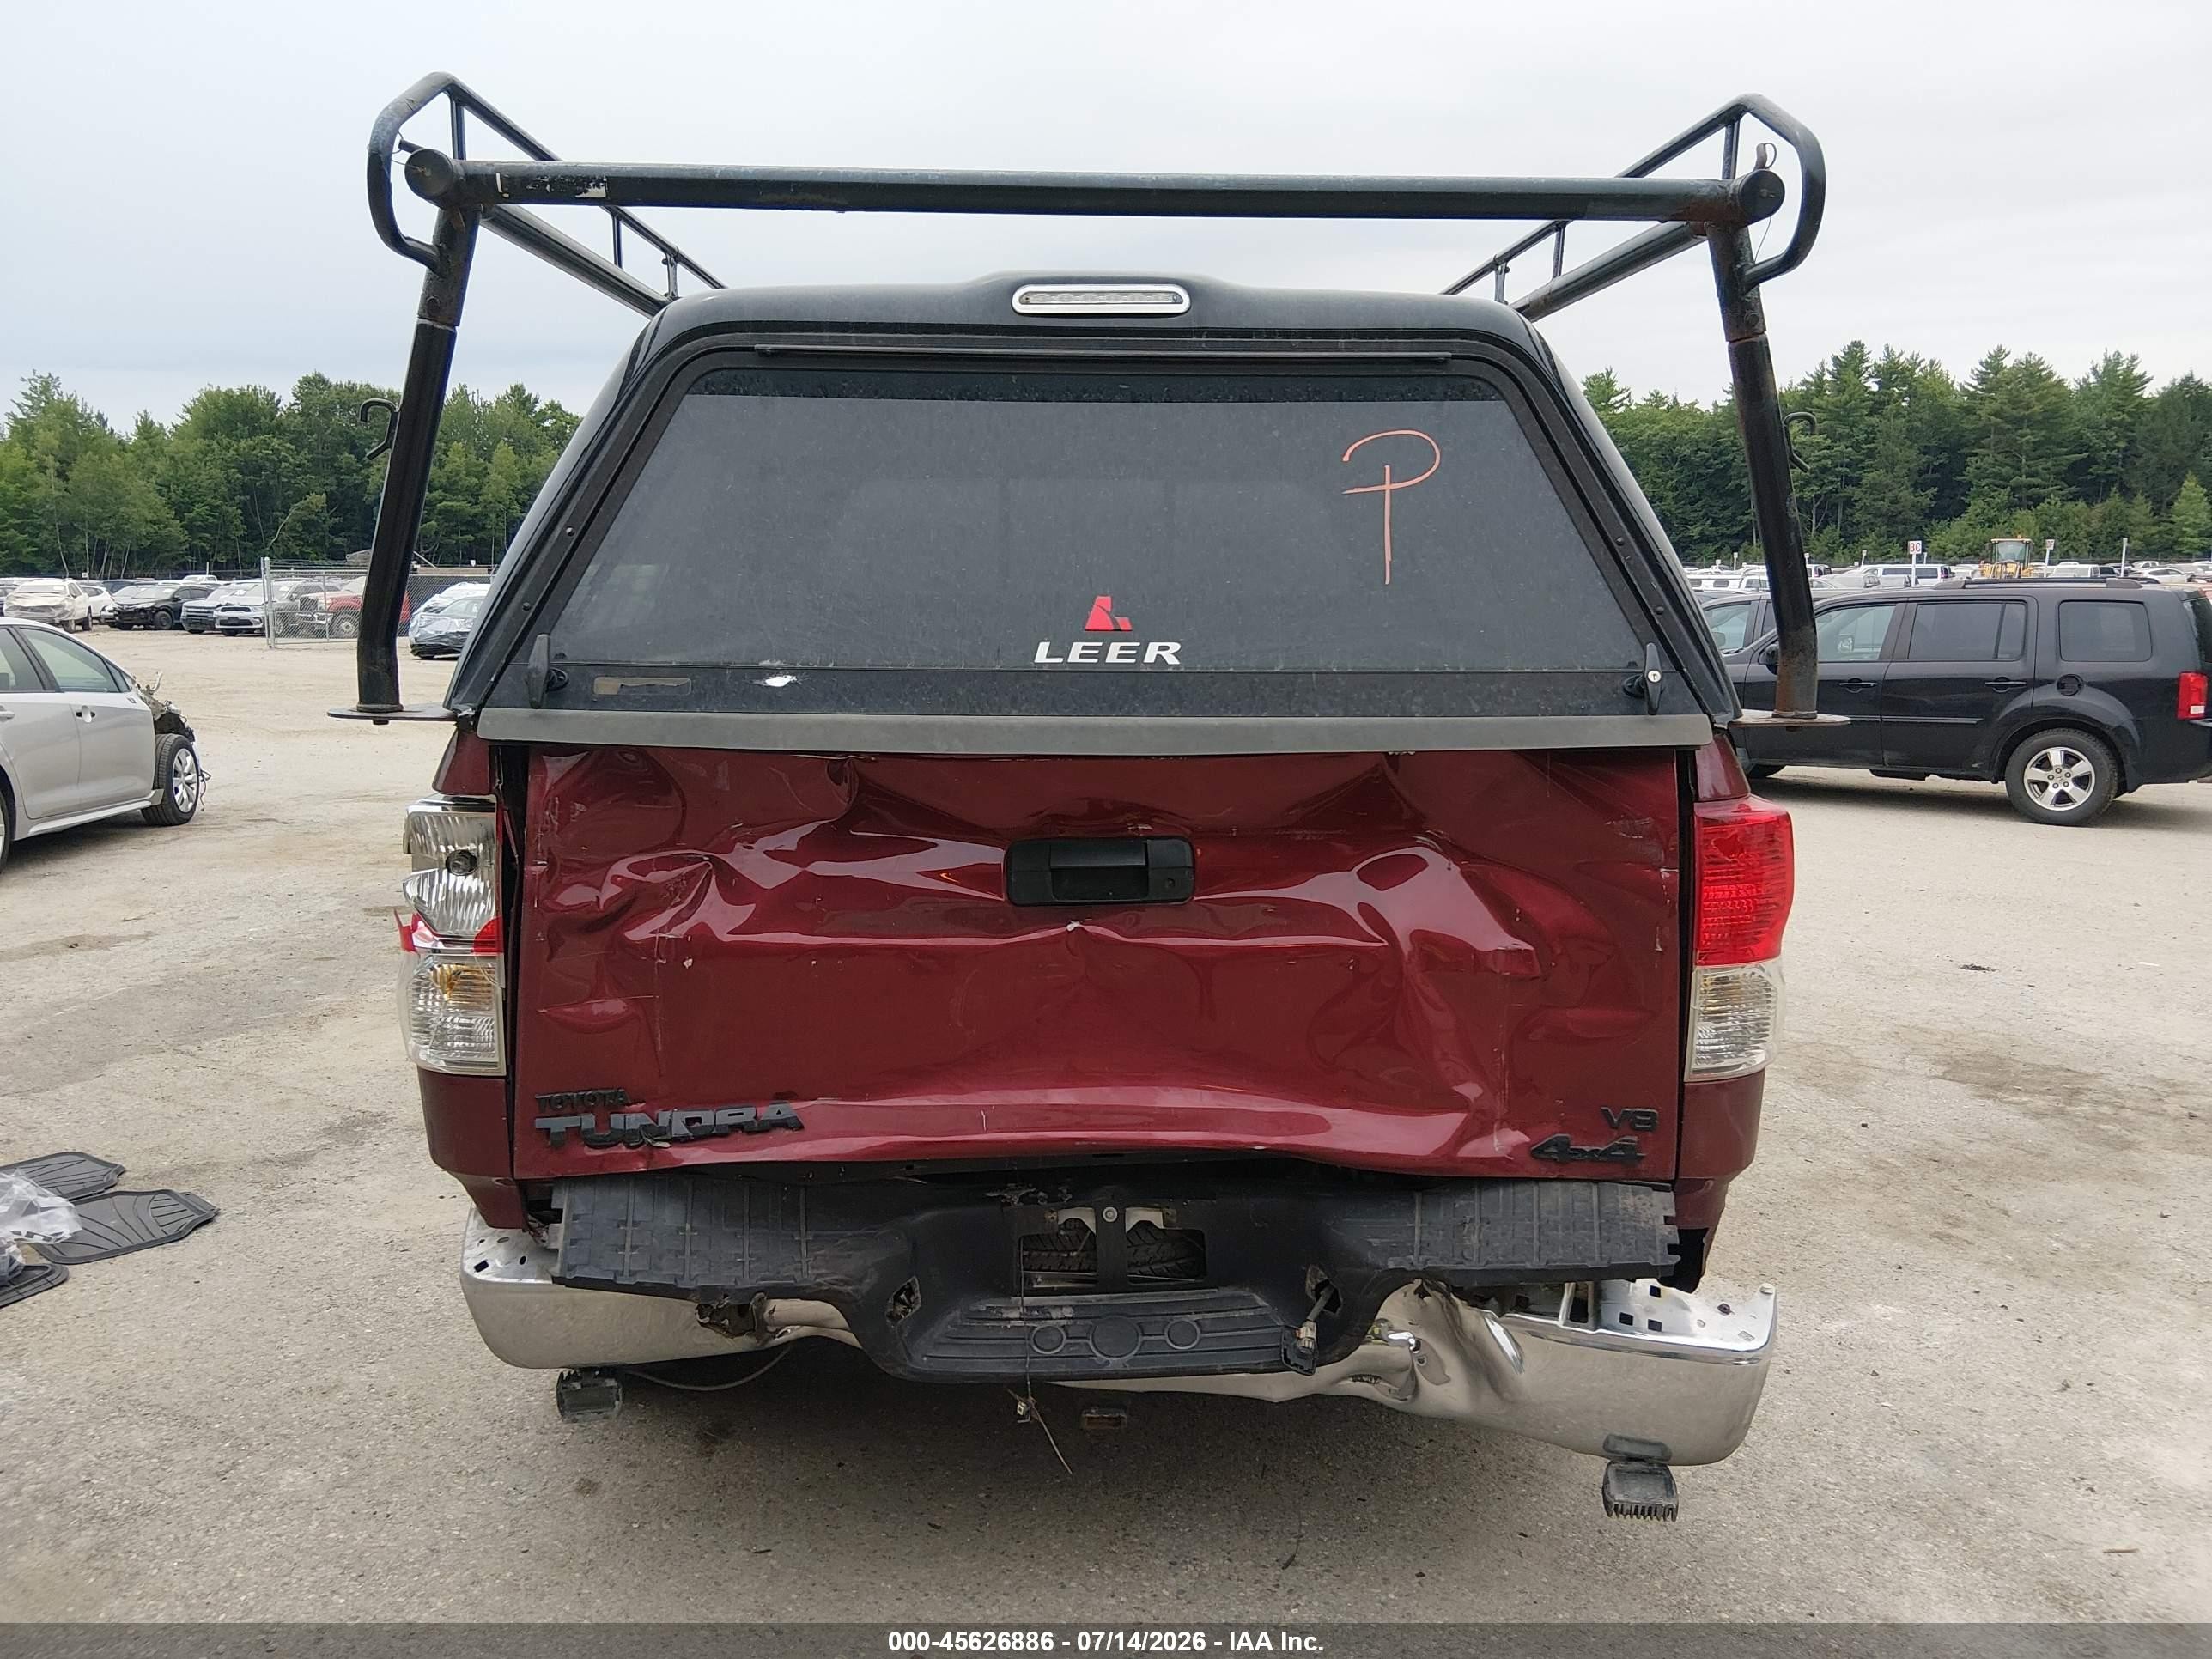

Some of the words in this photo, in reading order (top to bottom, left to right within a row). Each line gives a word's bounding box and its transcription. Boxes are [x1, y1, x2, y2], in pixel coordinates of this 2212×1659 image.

[1910, 542, 1921, 552] BC
[1034, 641, 1182, 665] LEER
[535, 1089, 631, 1113] TOYOTA
[535, 1101, 805, 1148] TUNDRA
[1600, 1106, 1659, 1132] V8
